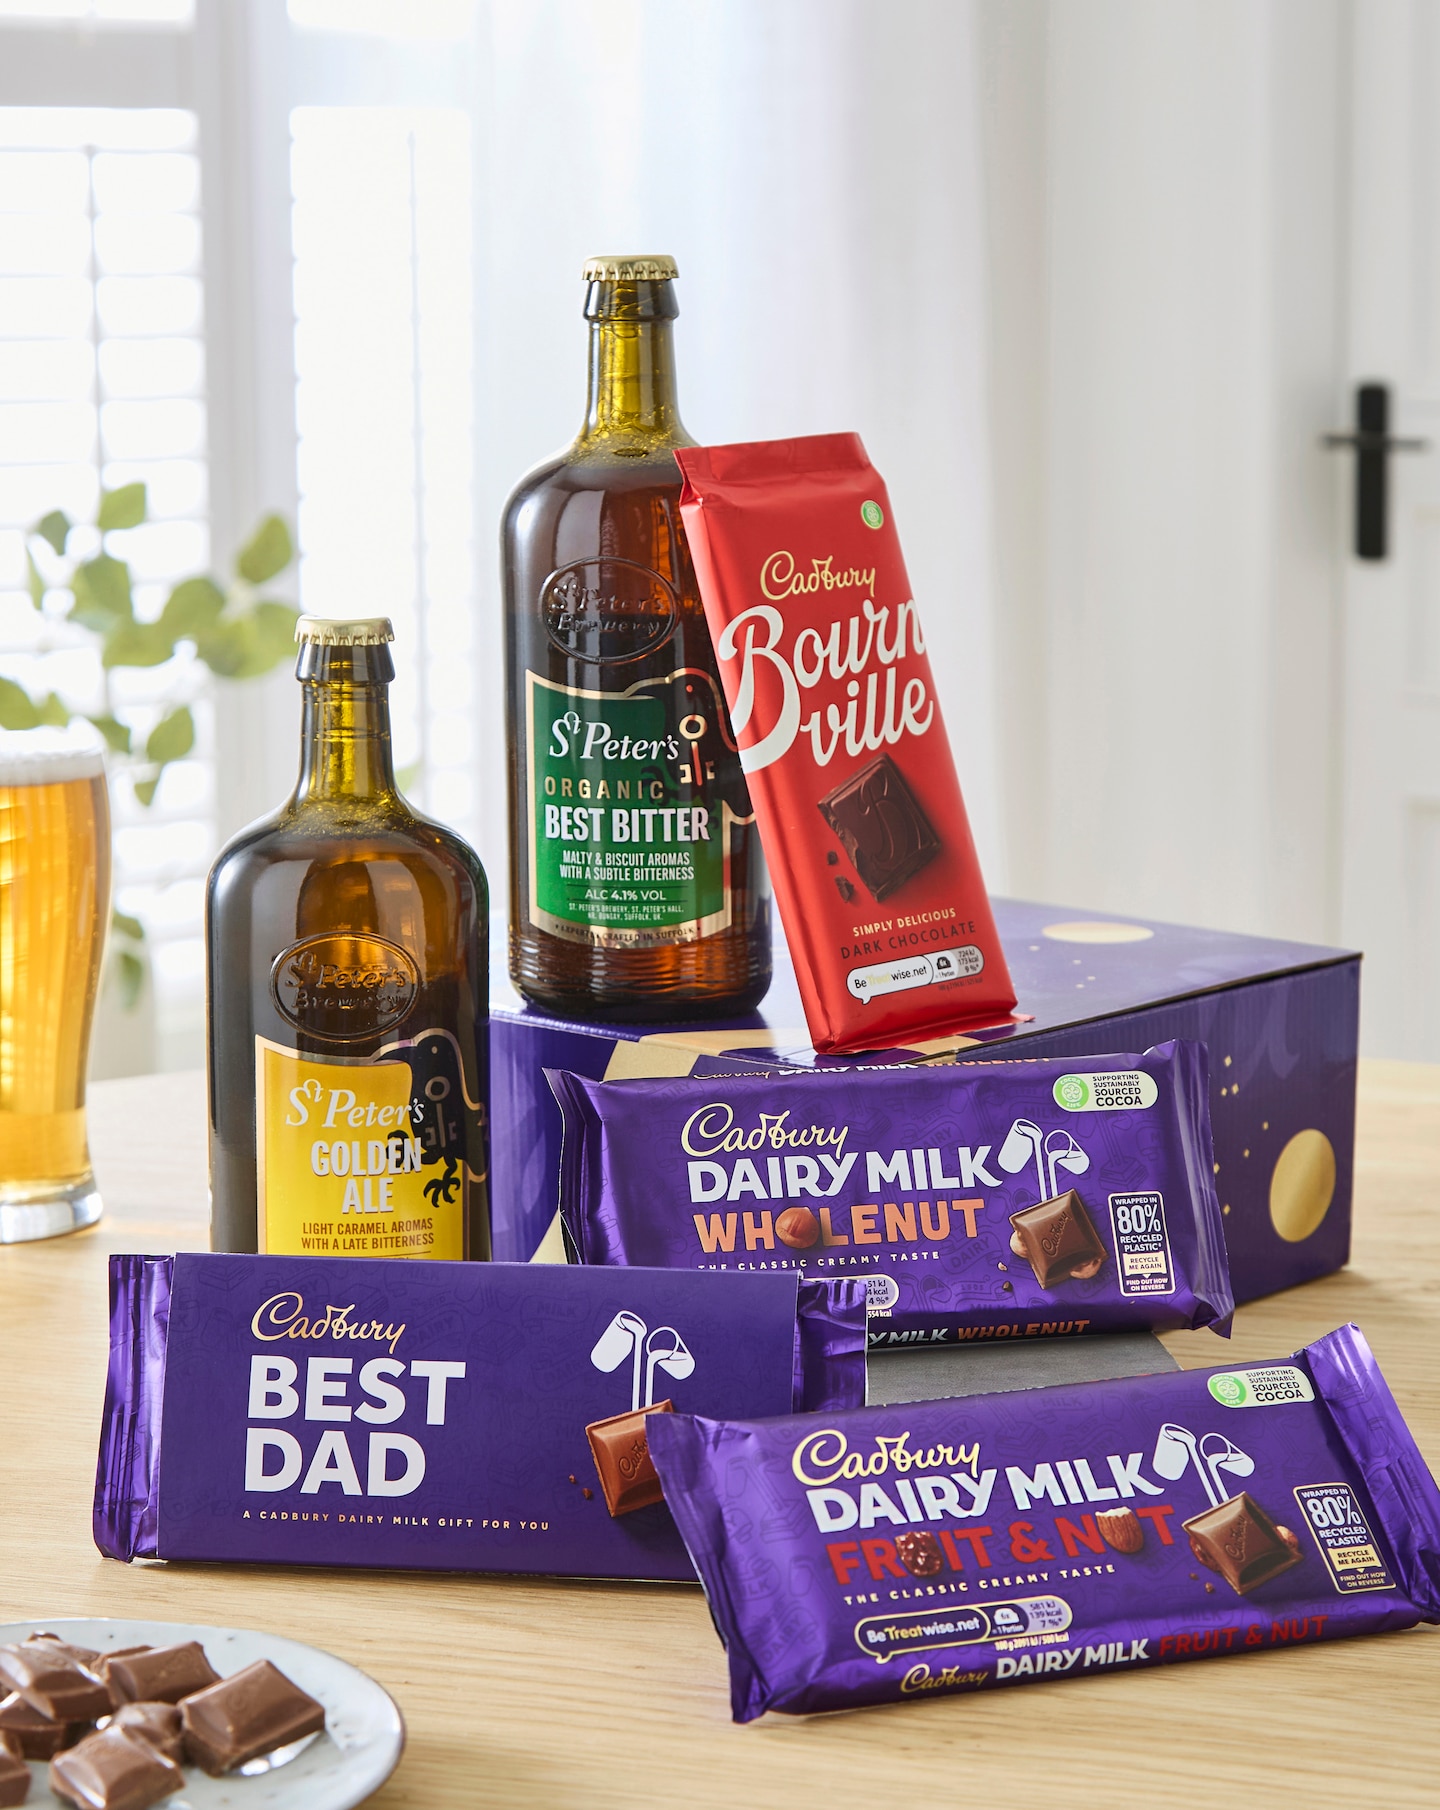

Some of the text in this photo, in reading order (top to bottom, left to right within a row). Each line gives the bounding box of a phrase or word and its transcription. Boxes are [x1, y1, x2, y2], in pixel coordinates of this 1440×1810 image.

[760, 550, 876, 600] Cadbury
[718, 599, 925, 774] Bourn
[800, 667, 934, 767] ville
[549, 711, 679, 760] St Peter's
[544, 776, 664, 799] ORGANIC
[545, 804, 710, 842] BEST BITTER
[563, 850, 690, 866] MALTY & BISCUIT AROMAS
[560, 864, 695, 881] WITH A SUBTLE BITTERNESS
[585, 889, 666, 901] ALC 4.1% VOL
[852, 907, 956, 937] SIMPLY DELICIOUS
[840, 921, 976, 959] DARK CHOCOLATE
[1093, 1080, 1140, 1088] SUSTAINABLY
[1094, 1087, 1141, 1097] SOURCED
[285, 1079, 424, 1128] St Peter's
[1096, 1096, 1142, 1107] COCOA
[681, 1102, 848, 1158] Cadbury
[311, 1137, 421, 1176] GOLDEN
[687, 1144, 1003, 1203] DAIRY MILK
[342, 1177, 394, 1214] ALE
[1115, 1197, 1149, 1205] WRAPPED
[303, 1217, 433, 1236] LIGHT CARAMEL AROMAS
[1116, 1203, 1161, 1234] 80%
[301, 1231, 434, 1250] WITH A LATE BITTERNESS
[1042, 1210, 1071, 1257] Cadbury
[1120, 1233, 1163, 1244] RECYCLED
[738, 1259, 807, 1271] CLASSIC
[818, 1254, 880, 1266] CREAMY
[890, 1251, 940, 1262] TASTE
[873, 1287, 888, 1296] kcal
[1141, 1283, 1165, 1291] REVERSE
[251, 1291, 406, 1354] Cadbury
[880, 1308, 892, 1318] kcal
[887, 1327, 948, 1343] MILK
[957, 1319, 1090, 1340] WHOLENUT
[1245, 1369, 1294, 1378] SUPPORTING
[1248, 1375, 1296, 1384] SUSTAINABLY
[247, 1354, 466, 1425] BEST
[1252, 1381, 1300, 1392] SOURCED
[1255, 1389, 1305, 1402] COCOA
[244, 1427, 426, 1497] DAD
[792, 1429, 981, 1486] Cadbury
[805, 1452, 1165, 1534] DAIRY MILK
[1301, 1488, 1339, 1498] WRAPPED
[242, 1510, 549, 1530] A CADBURY DAIRY MILK GIFT FOR YOU
[1306, 1495, 1361, 1528] 80%
[1008, 1520, 1056, 1563] &
[1318, 1526, 1367, 1539] RECYCLED
[1337, 1549, 1370, 1558] RECYCLE
[1351, 1556, 1375, 1564] AGAIN
[844, 1564, 1116, 1605] THE CLASSIC CREAMY TASTE
[1358, 1577, 1386, 1587] REVERSE
[1045, 1608, 1063, 1617] kcal
[1040, 1619, 1046, 1628] 7
[900, 1614, 1329, 1693] Cadbury DAIRY MILK FRUIT & NUT
